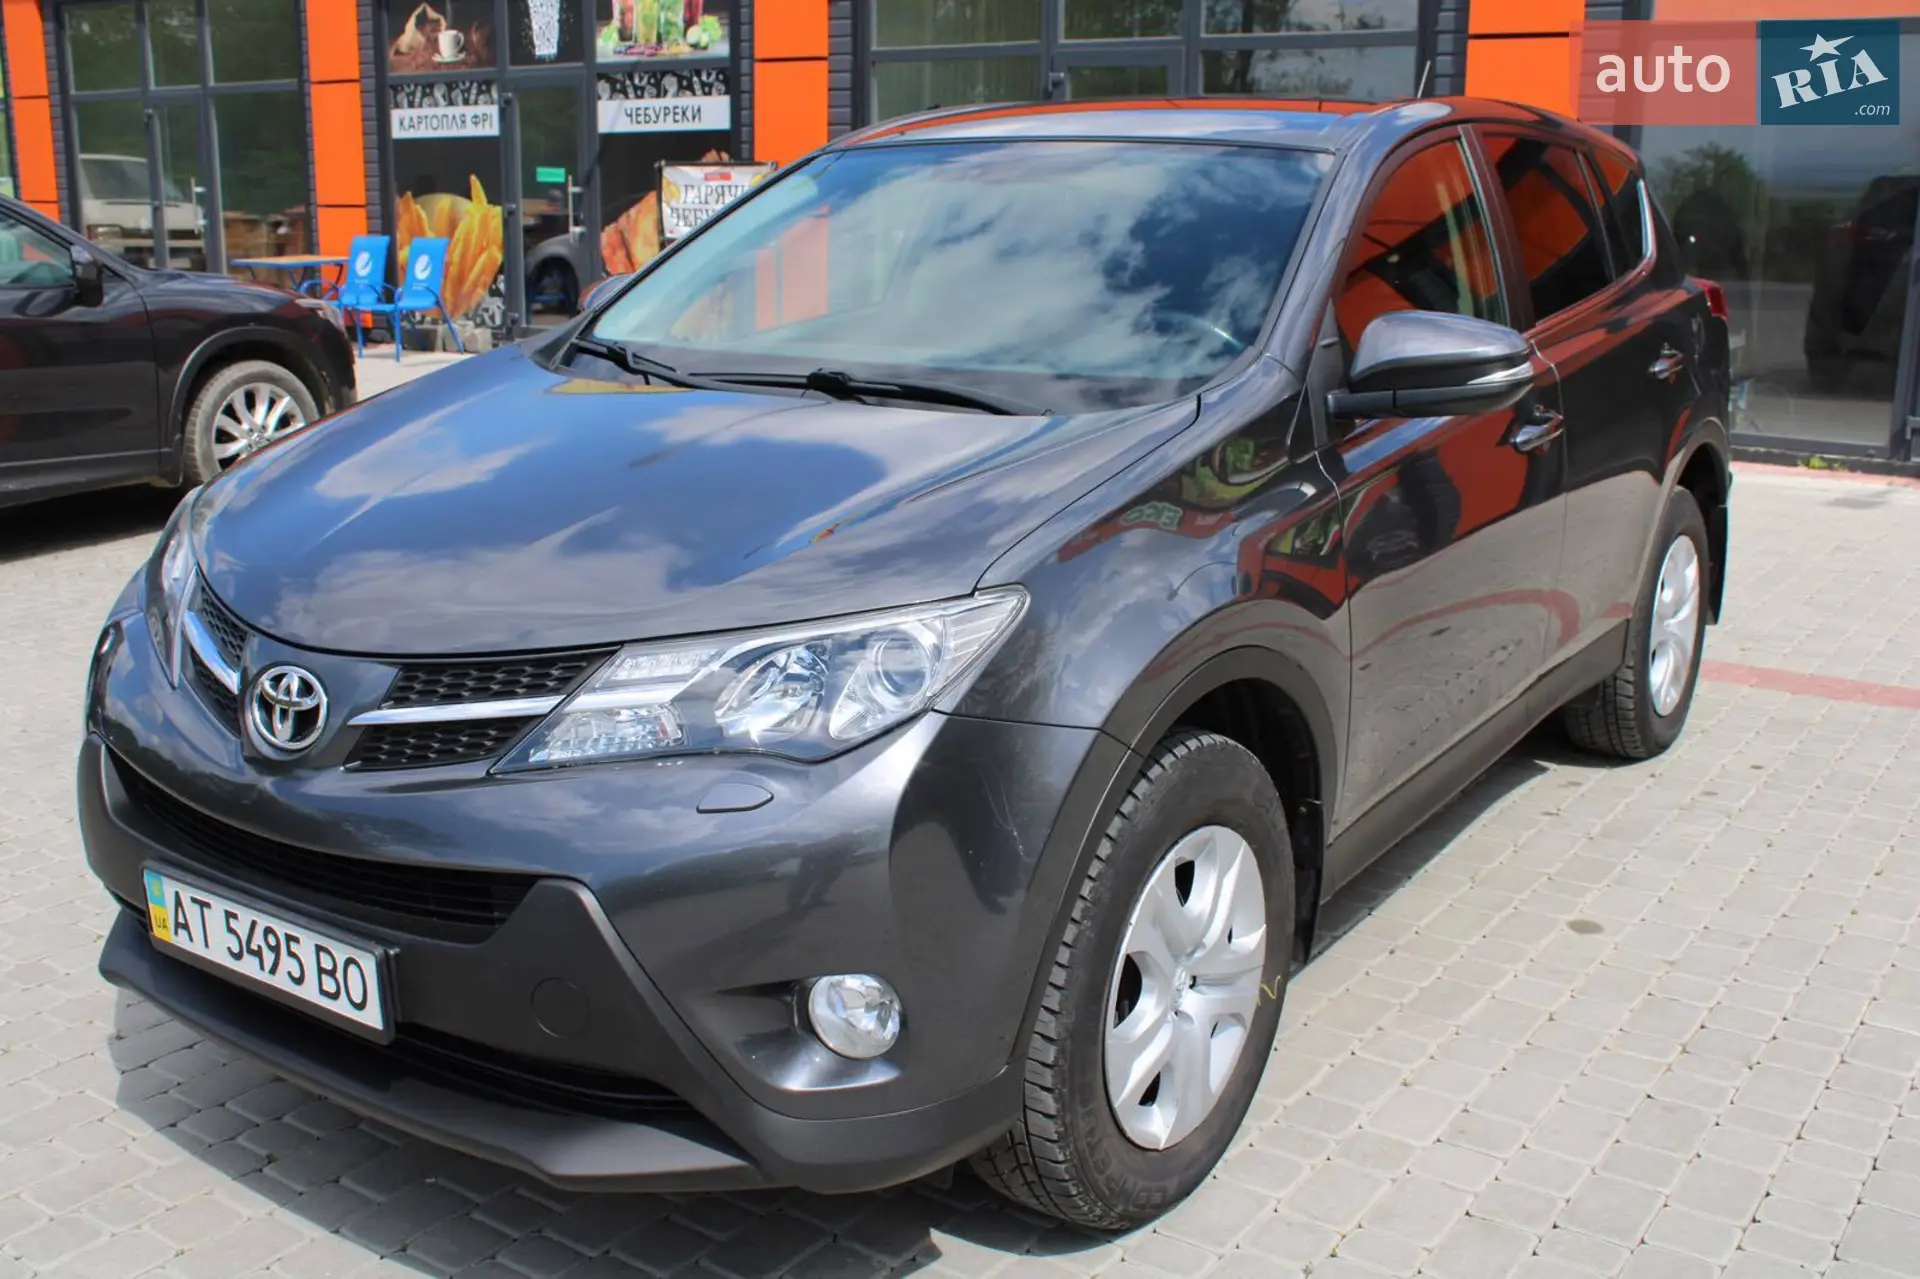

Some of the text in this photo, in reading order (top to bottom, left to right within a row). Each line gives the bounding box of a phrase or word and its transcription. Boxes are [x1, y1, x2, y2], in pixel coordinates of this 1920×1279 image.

[399, 112, 493, 131] КАРТОПЛЯ ФРІ
[624, 104, 702, 125] ЧЕБУРЕКИ
[174, 890, 211, 949] AT
[223, 909, 306, 986] 5495
